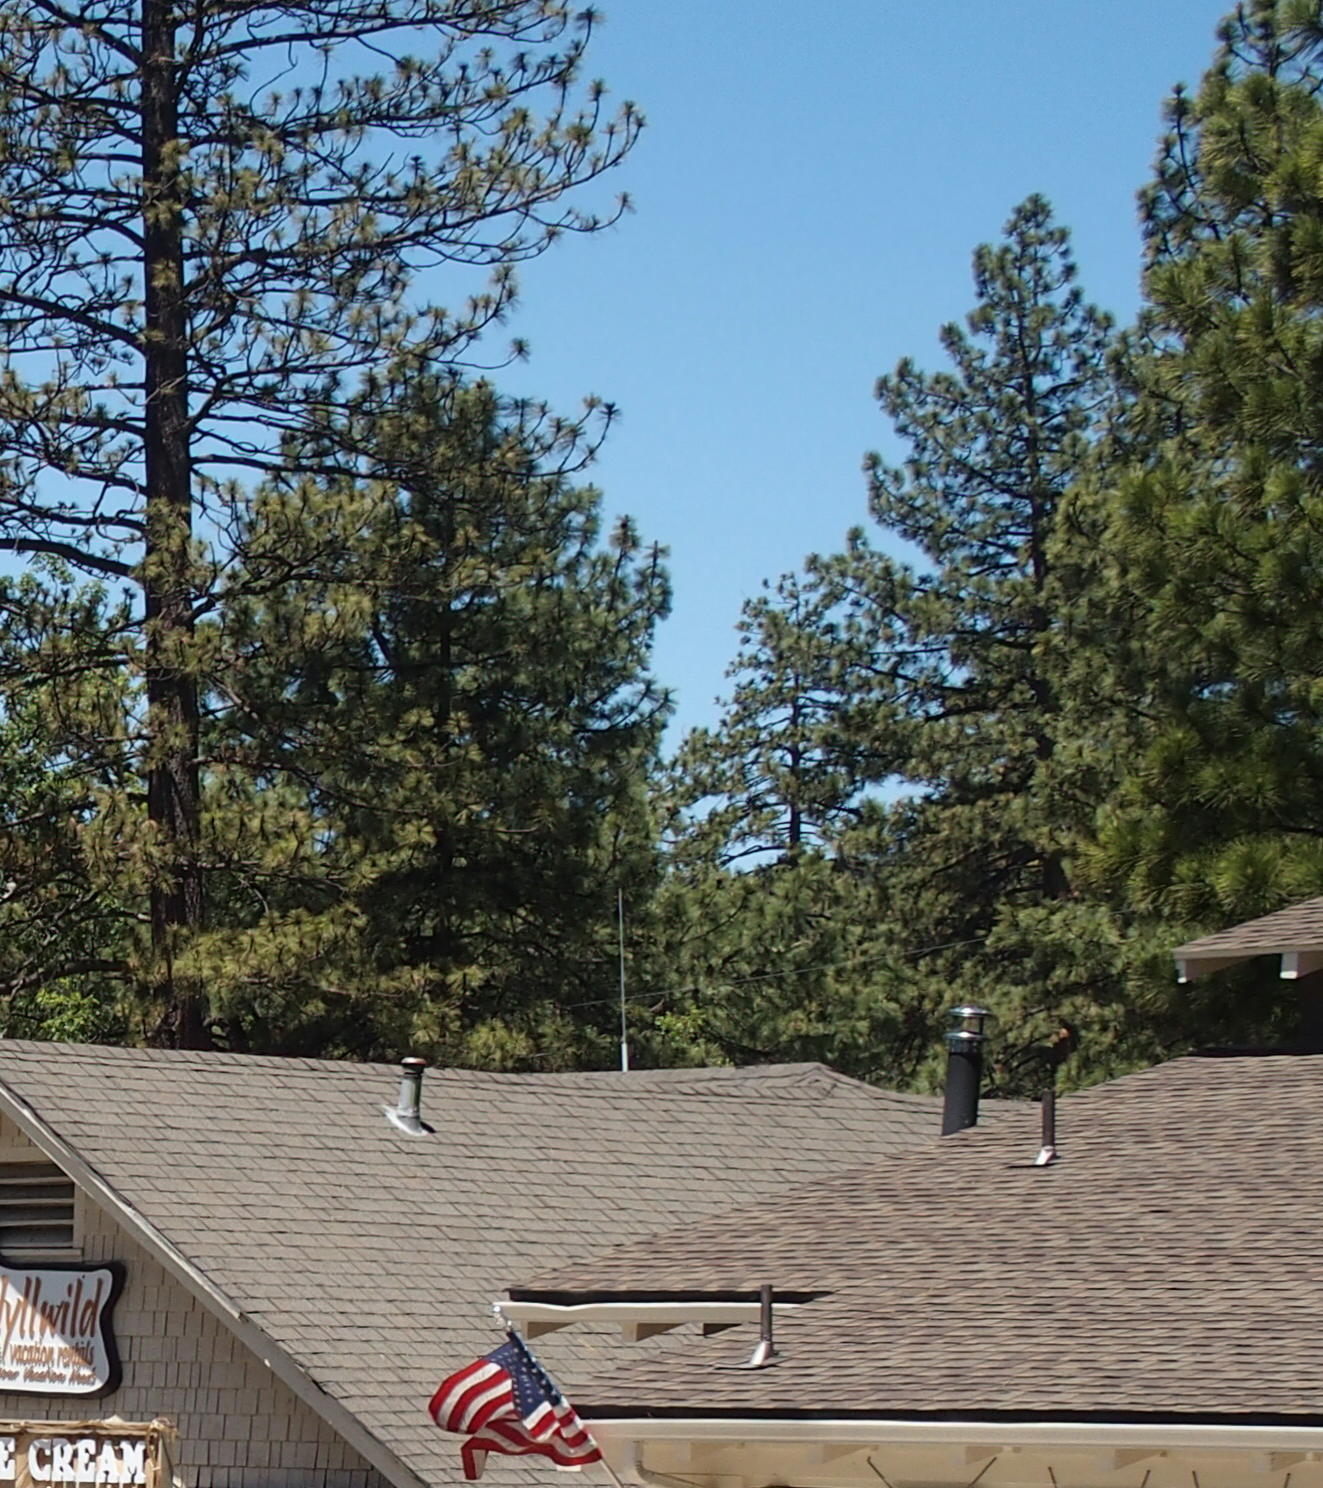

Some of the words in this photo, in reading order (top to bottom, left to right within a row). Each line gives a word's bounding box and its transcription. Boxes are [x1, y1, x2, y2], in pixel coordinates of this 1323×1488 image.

[10, 1341, 55, 1366] vacation
[57, 1340, 95, 1367] rentals
[28, 1437, 147, 1484] CREAM
